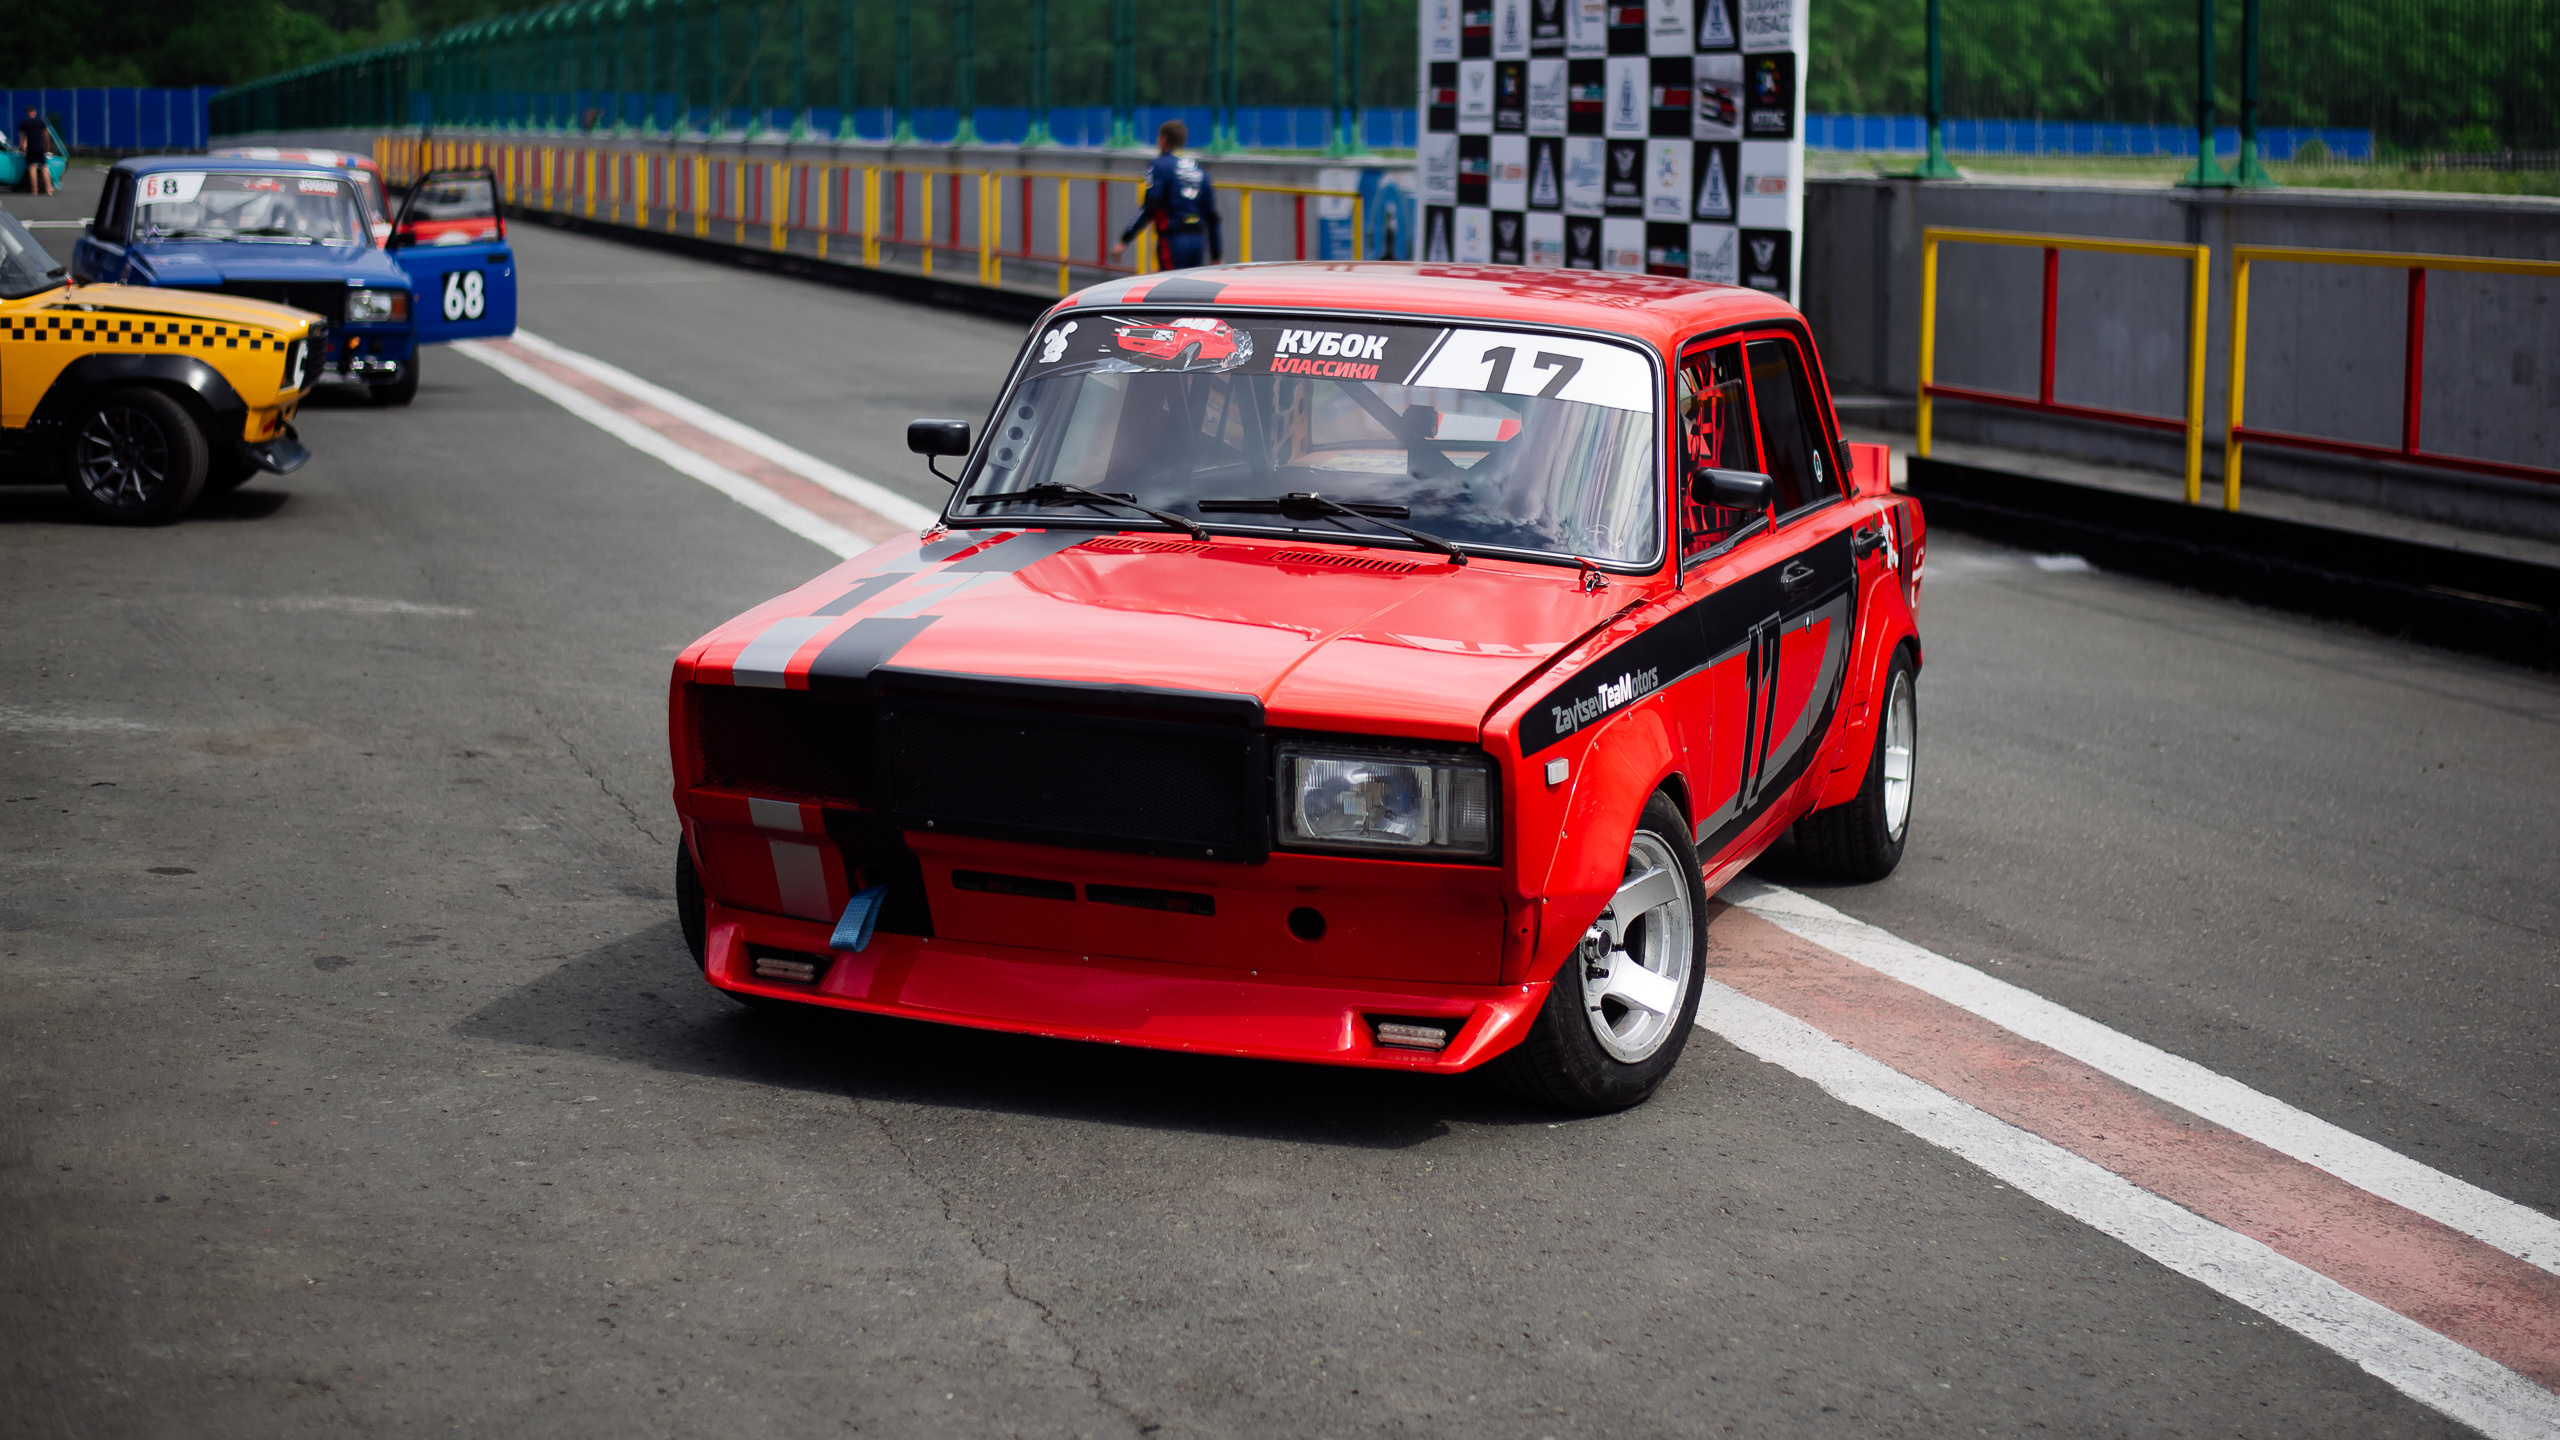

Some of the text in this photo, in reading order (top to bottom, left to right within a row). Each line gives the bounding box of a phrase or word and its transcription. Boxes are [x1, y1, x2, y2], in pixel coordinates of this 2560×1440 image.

[444, 270, 484, 320] 68
[1270, 357, 1379, 380] КЛАССИКИ
[1276, 329, 1389, 360] КУБОК
[1481, 346, 1584, 399] 17
[1552, 666, 1659, 734] ZaytsevTeaMotors
[1731, 611, 1782, 820] 17
